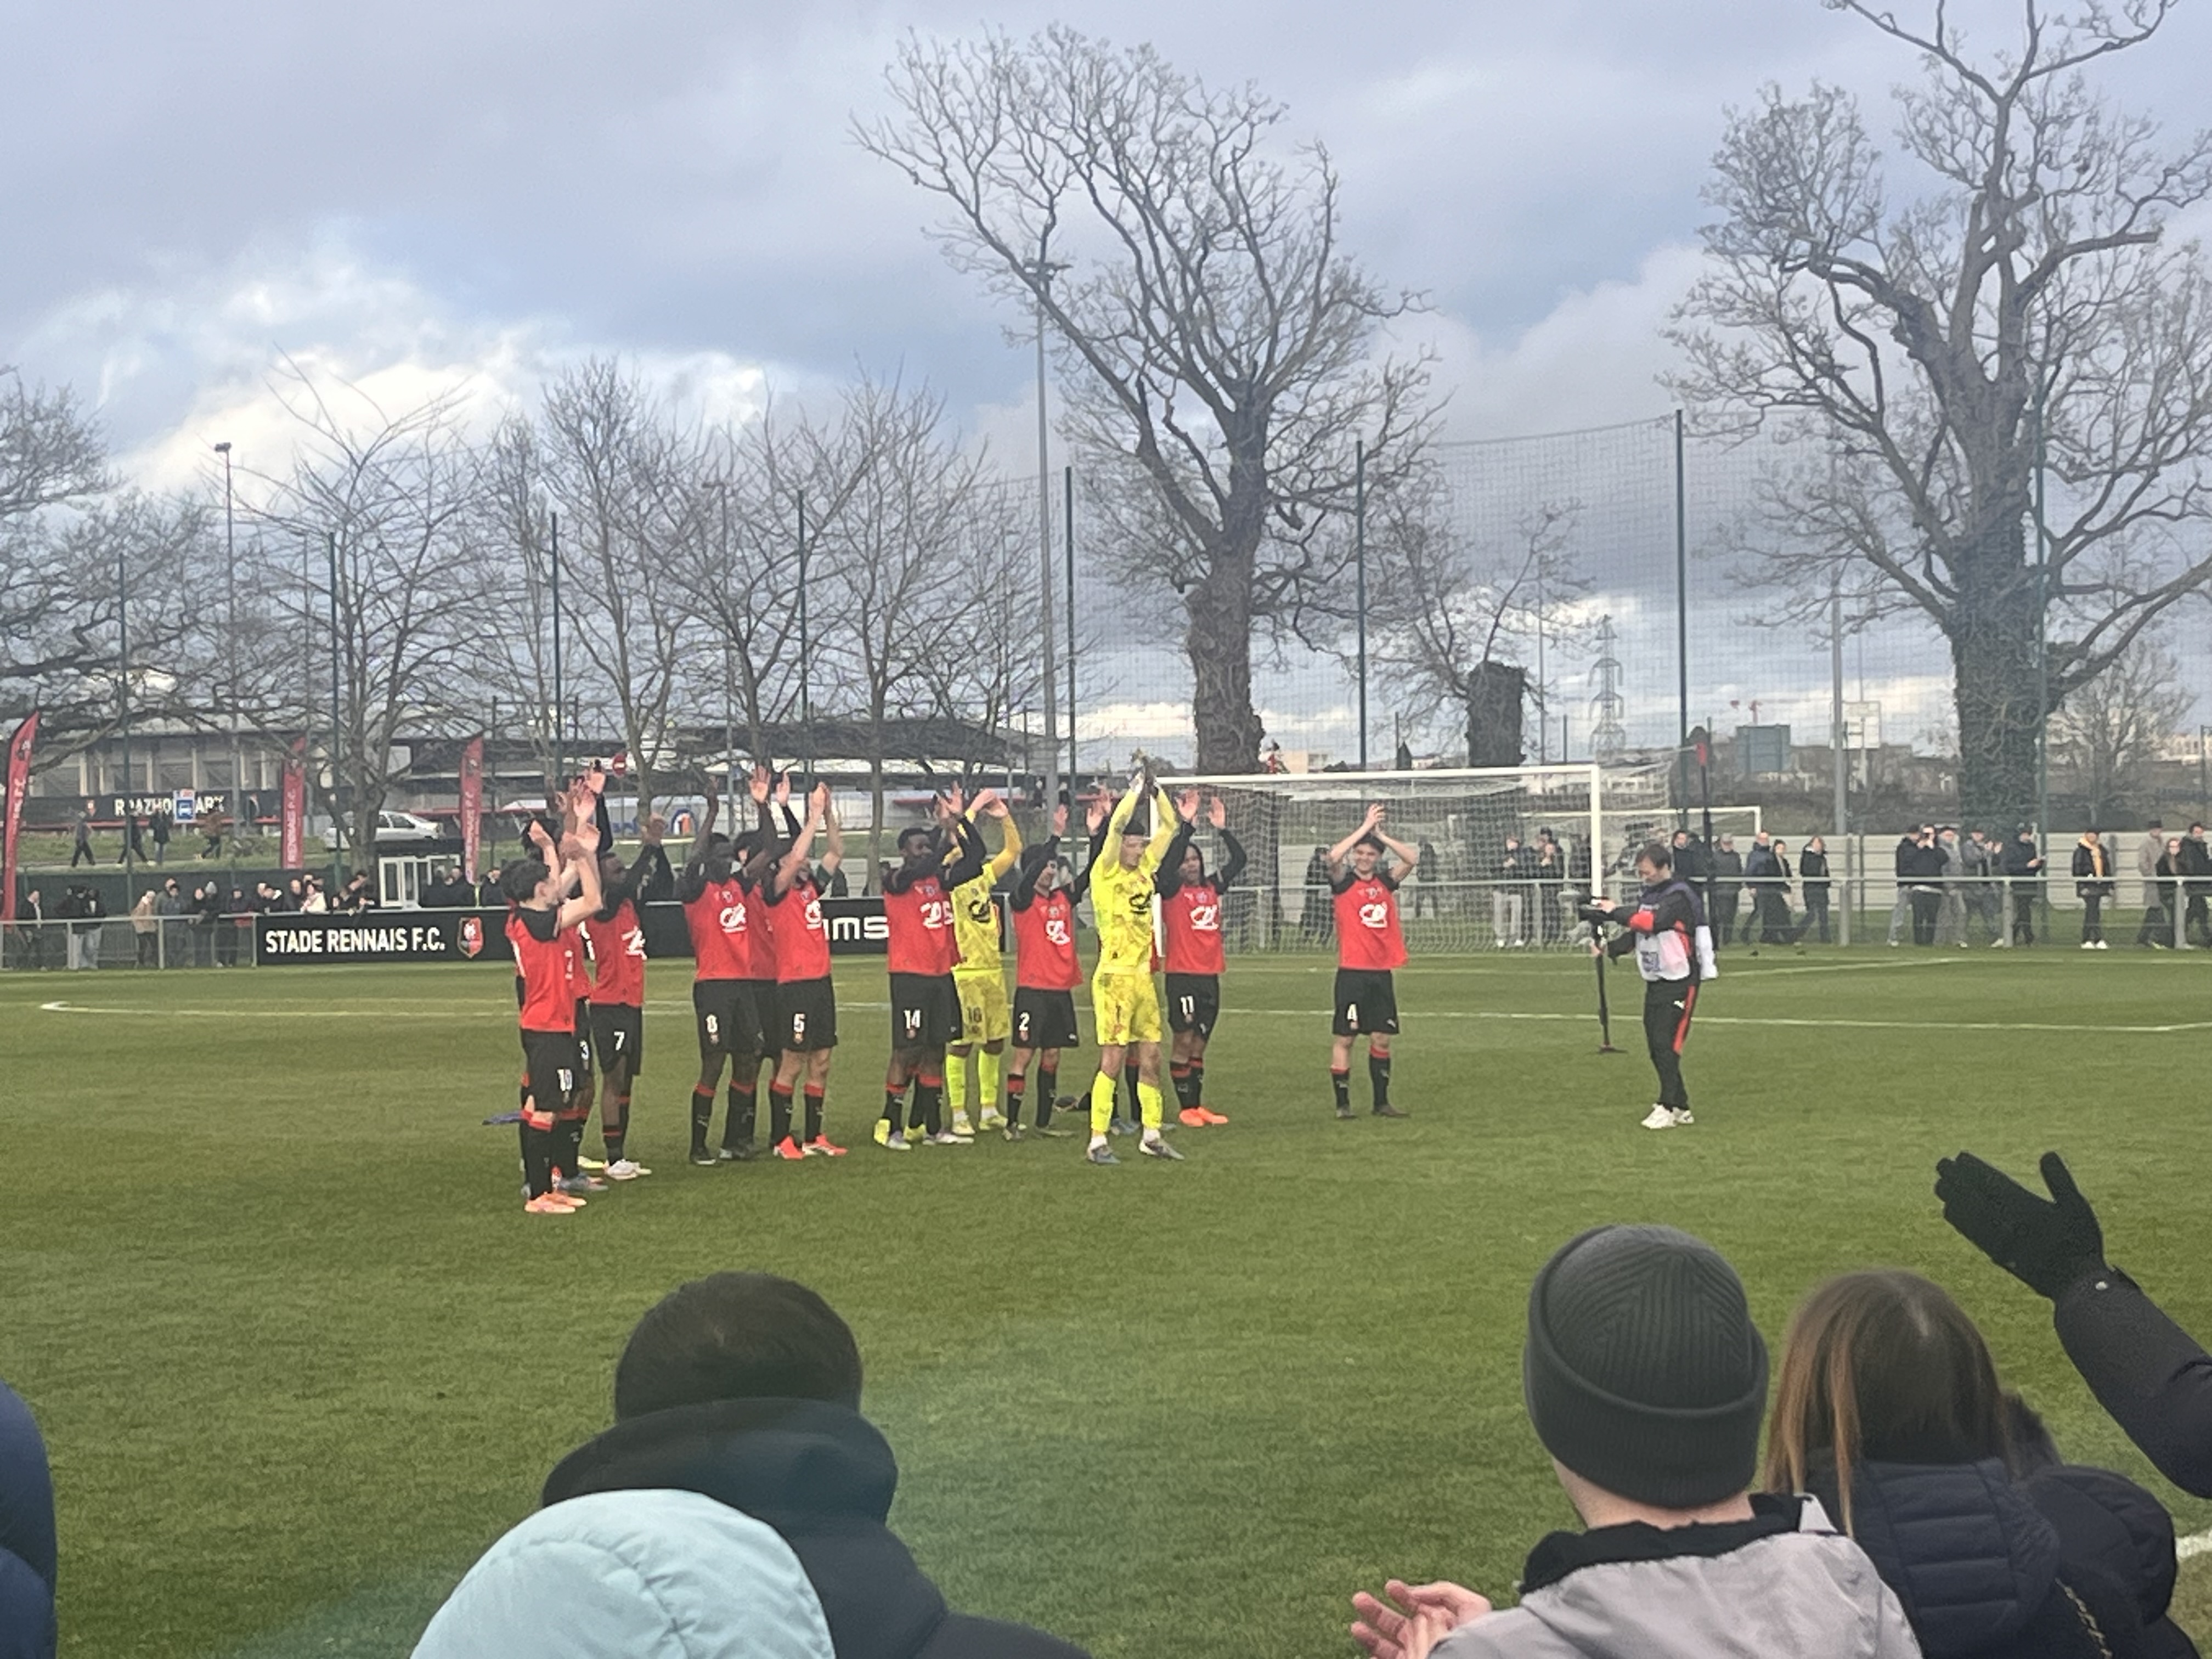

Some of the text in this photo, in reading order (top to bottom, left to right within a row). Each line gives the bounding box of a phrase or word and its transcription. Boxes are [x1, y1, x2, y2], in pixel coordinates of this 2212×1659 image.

[266, 927, 446, 952] STADE RENNAIS F.C.
[1181, 996, 1195, 1015] 11
[1347, 1003, 1358, 1021] 4
[793, 1013, 805, 1032] 5
[904, 1009, 921, 1029] 14
[1019, 1012, 1030, 1031] 2
[579, 1040, 590, 1060] 3
[614, 1031, 625, 1051] 7
